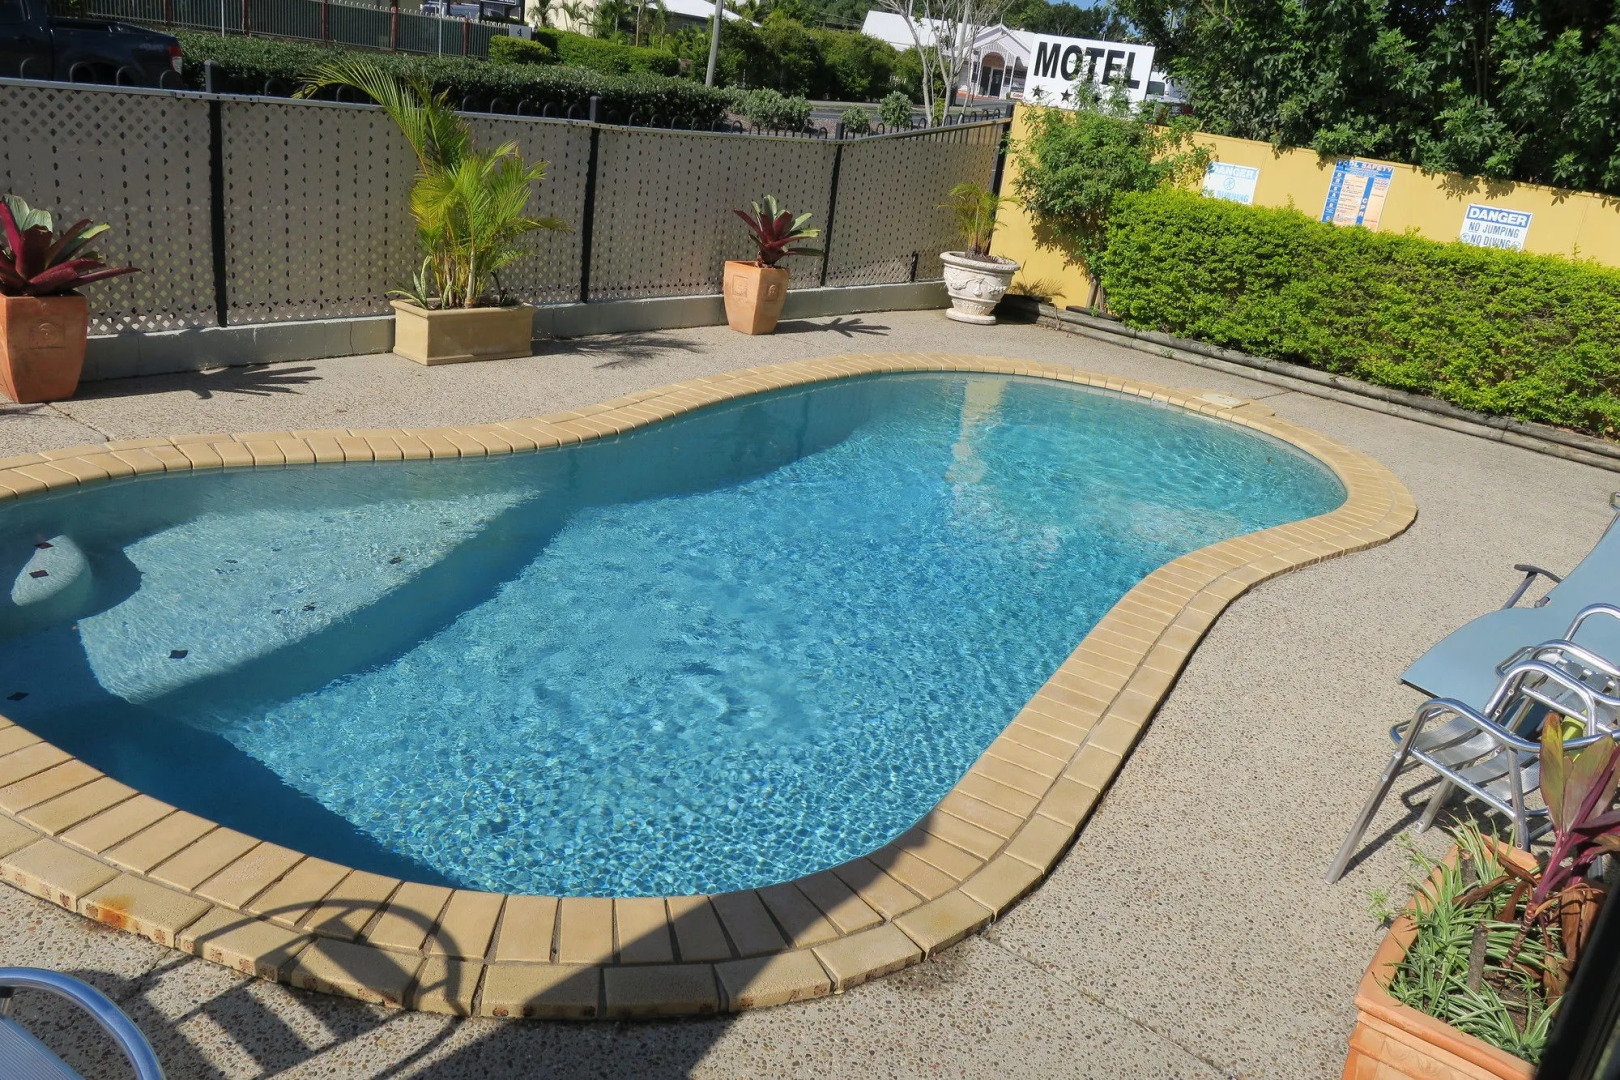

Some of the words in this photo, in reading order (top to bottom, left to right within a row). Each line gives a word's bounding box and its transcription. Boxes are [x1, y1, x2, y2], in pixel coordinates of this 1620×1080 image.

[517, 28, 523, 37] 4
[1033, 41, 1140, 89] MOTEL
[1363, 162, 1394, 172] SAFETY
[1469, 207, 1527, 225] DANGER
[1469, 222, 1480, 232] NO
[1483, 224, 1520, 239] JUMPING
[1471, 234, 1482, 245] NO
[1484, 236, 1511, 249] DIVING
